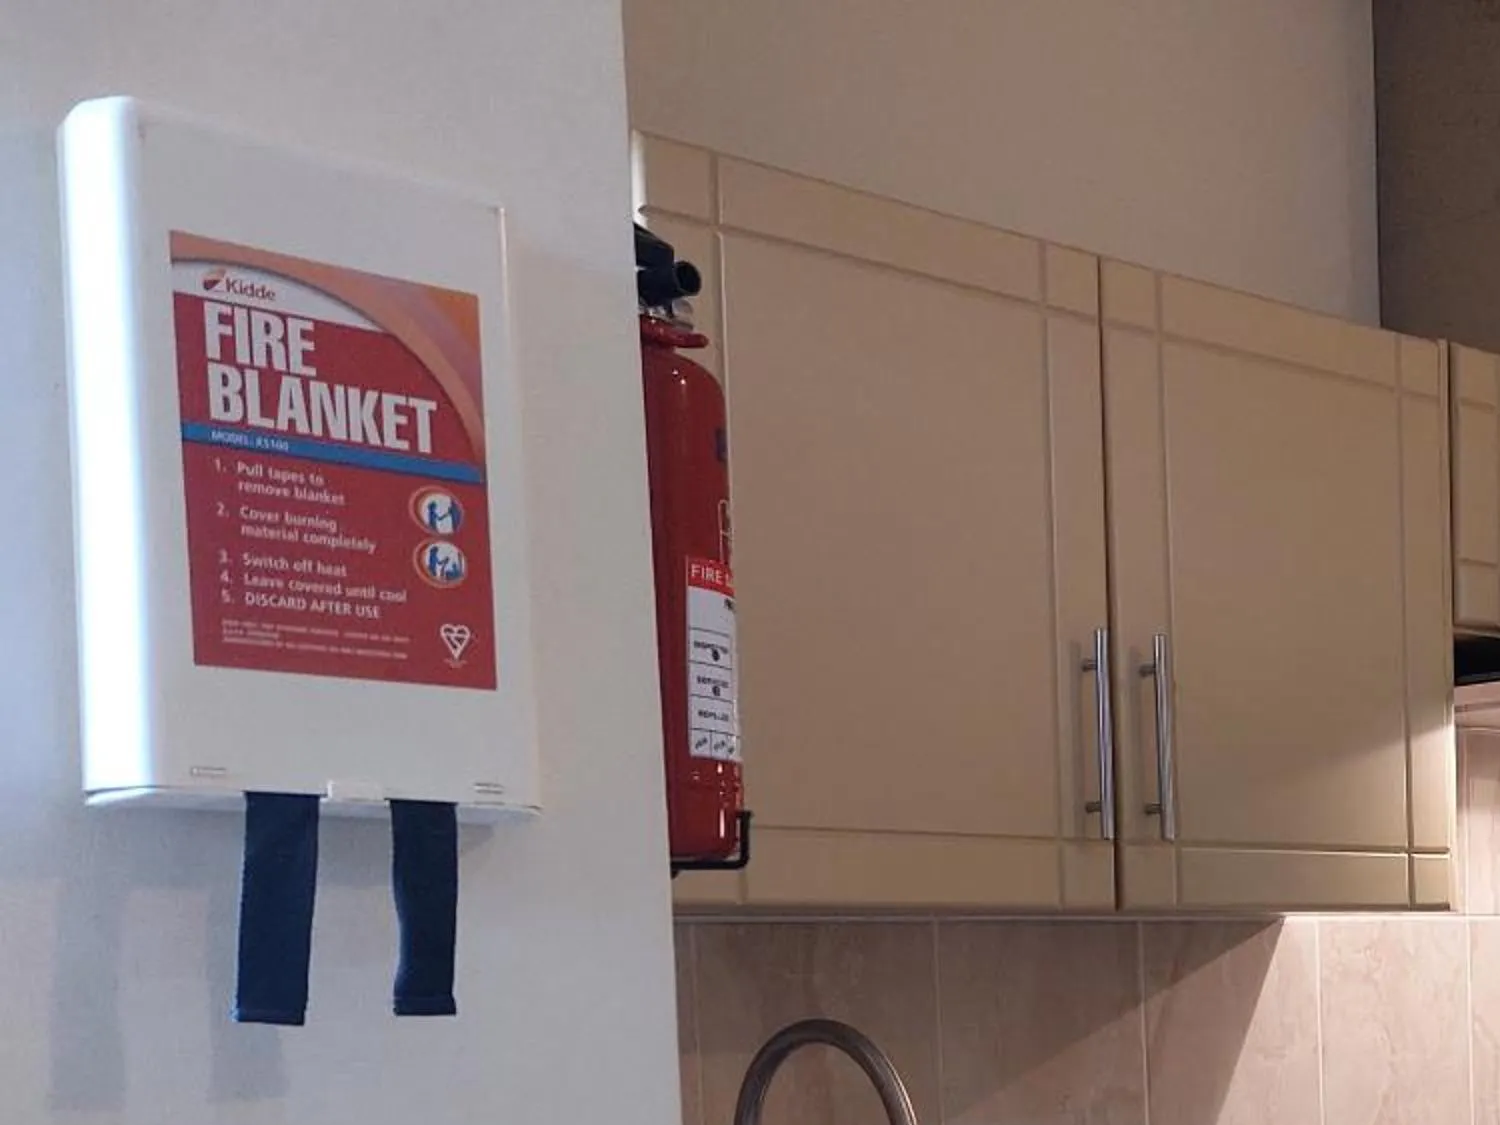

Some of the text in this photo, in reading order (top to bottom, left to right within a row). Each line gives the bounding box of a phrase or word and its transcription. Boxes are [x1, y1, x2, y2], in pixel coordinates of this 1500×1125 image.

[225, 277, 276, 301] Kidde
[203, 299, 316, 376] FIRE
[207, 360, 437, 454] BLANKET
[237, 461, 263, 478] Pull
[268, 467, 304, 484] tapes
[309, 472, 324, 486] to
[238, 480, 345, 505] remove blanket
[240, 505, 279, 522] Cover
[285, 512, 337, 533] burning
[241, 524, 376, 554] material completely
[243, 552, 288, 569] Switch
[293, 558, 312, 573] off
[317, 561, 347, 577] heat
[691, 563, 723, 585] FIRE
[244, 572, 283, 588] Leave
[288, 578, 342, 596] covered
[345, 585, 376, 600] until
[379, 588, 407, 603] cool
[245, 592, 306, 610] DISCARD
[310, 598, 352, 615] AFTER
[356, 604, 380, 620] USE
